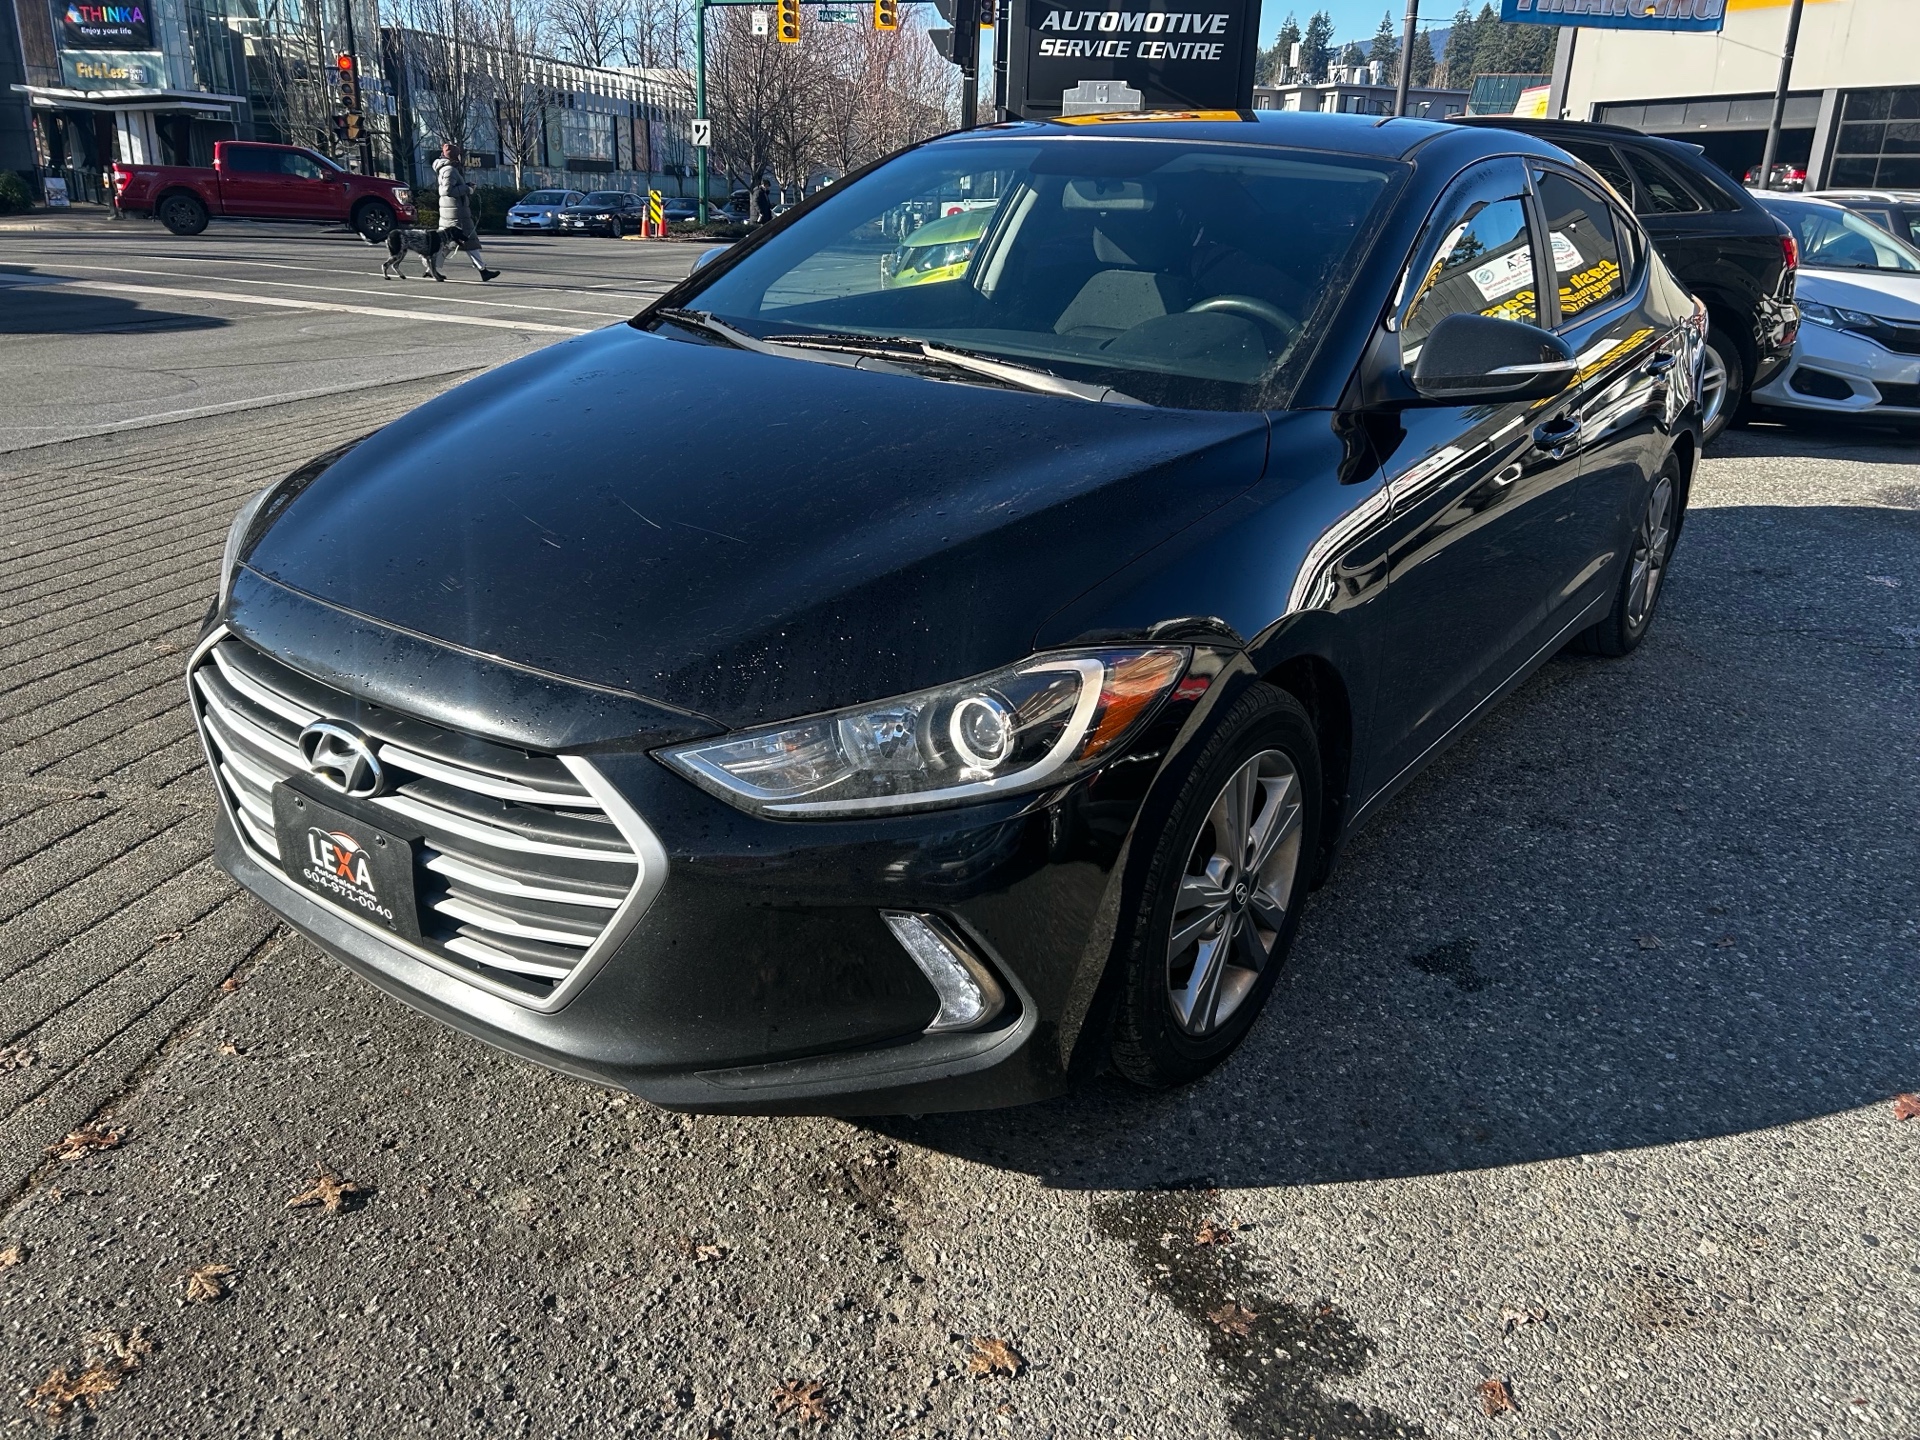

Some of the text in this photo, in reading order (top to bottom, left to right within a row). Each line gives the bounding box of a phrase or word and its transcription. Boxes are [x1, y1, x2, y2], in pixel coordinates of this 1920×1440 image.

[1516, 0, 1723, 20] NCING
[81, 26, 100, 34] Enjoy
[1039, 11, 1229, 33] AUTOMOTIVE
[1038, 38, 1225, 61] SERVICE CENTRE
[308, 832, 375, 893] LEXA
[303, 868, 393, 920] 604-971-0040
